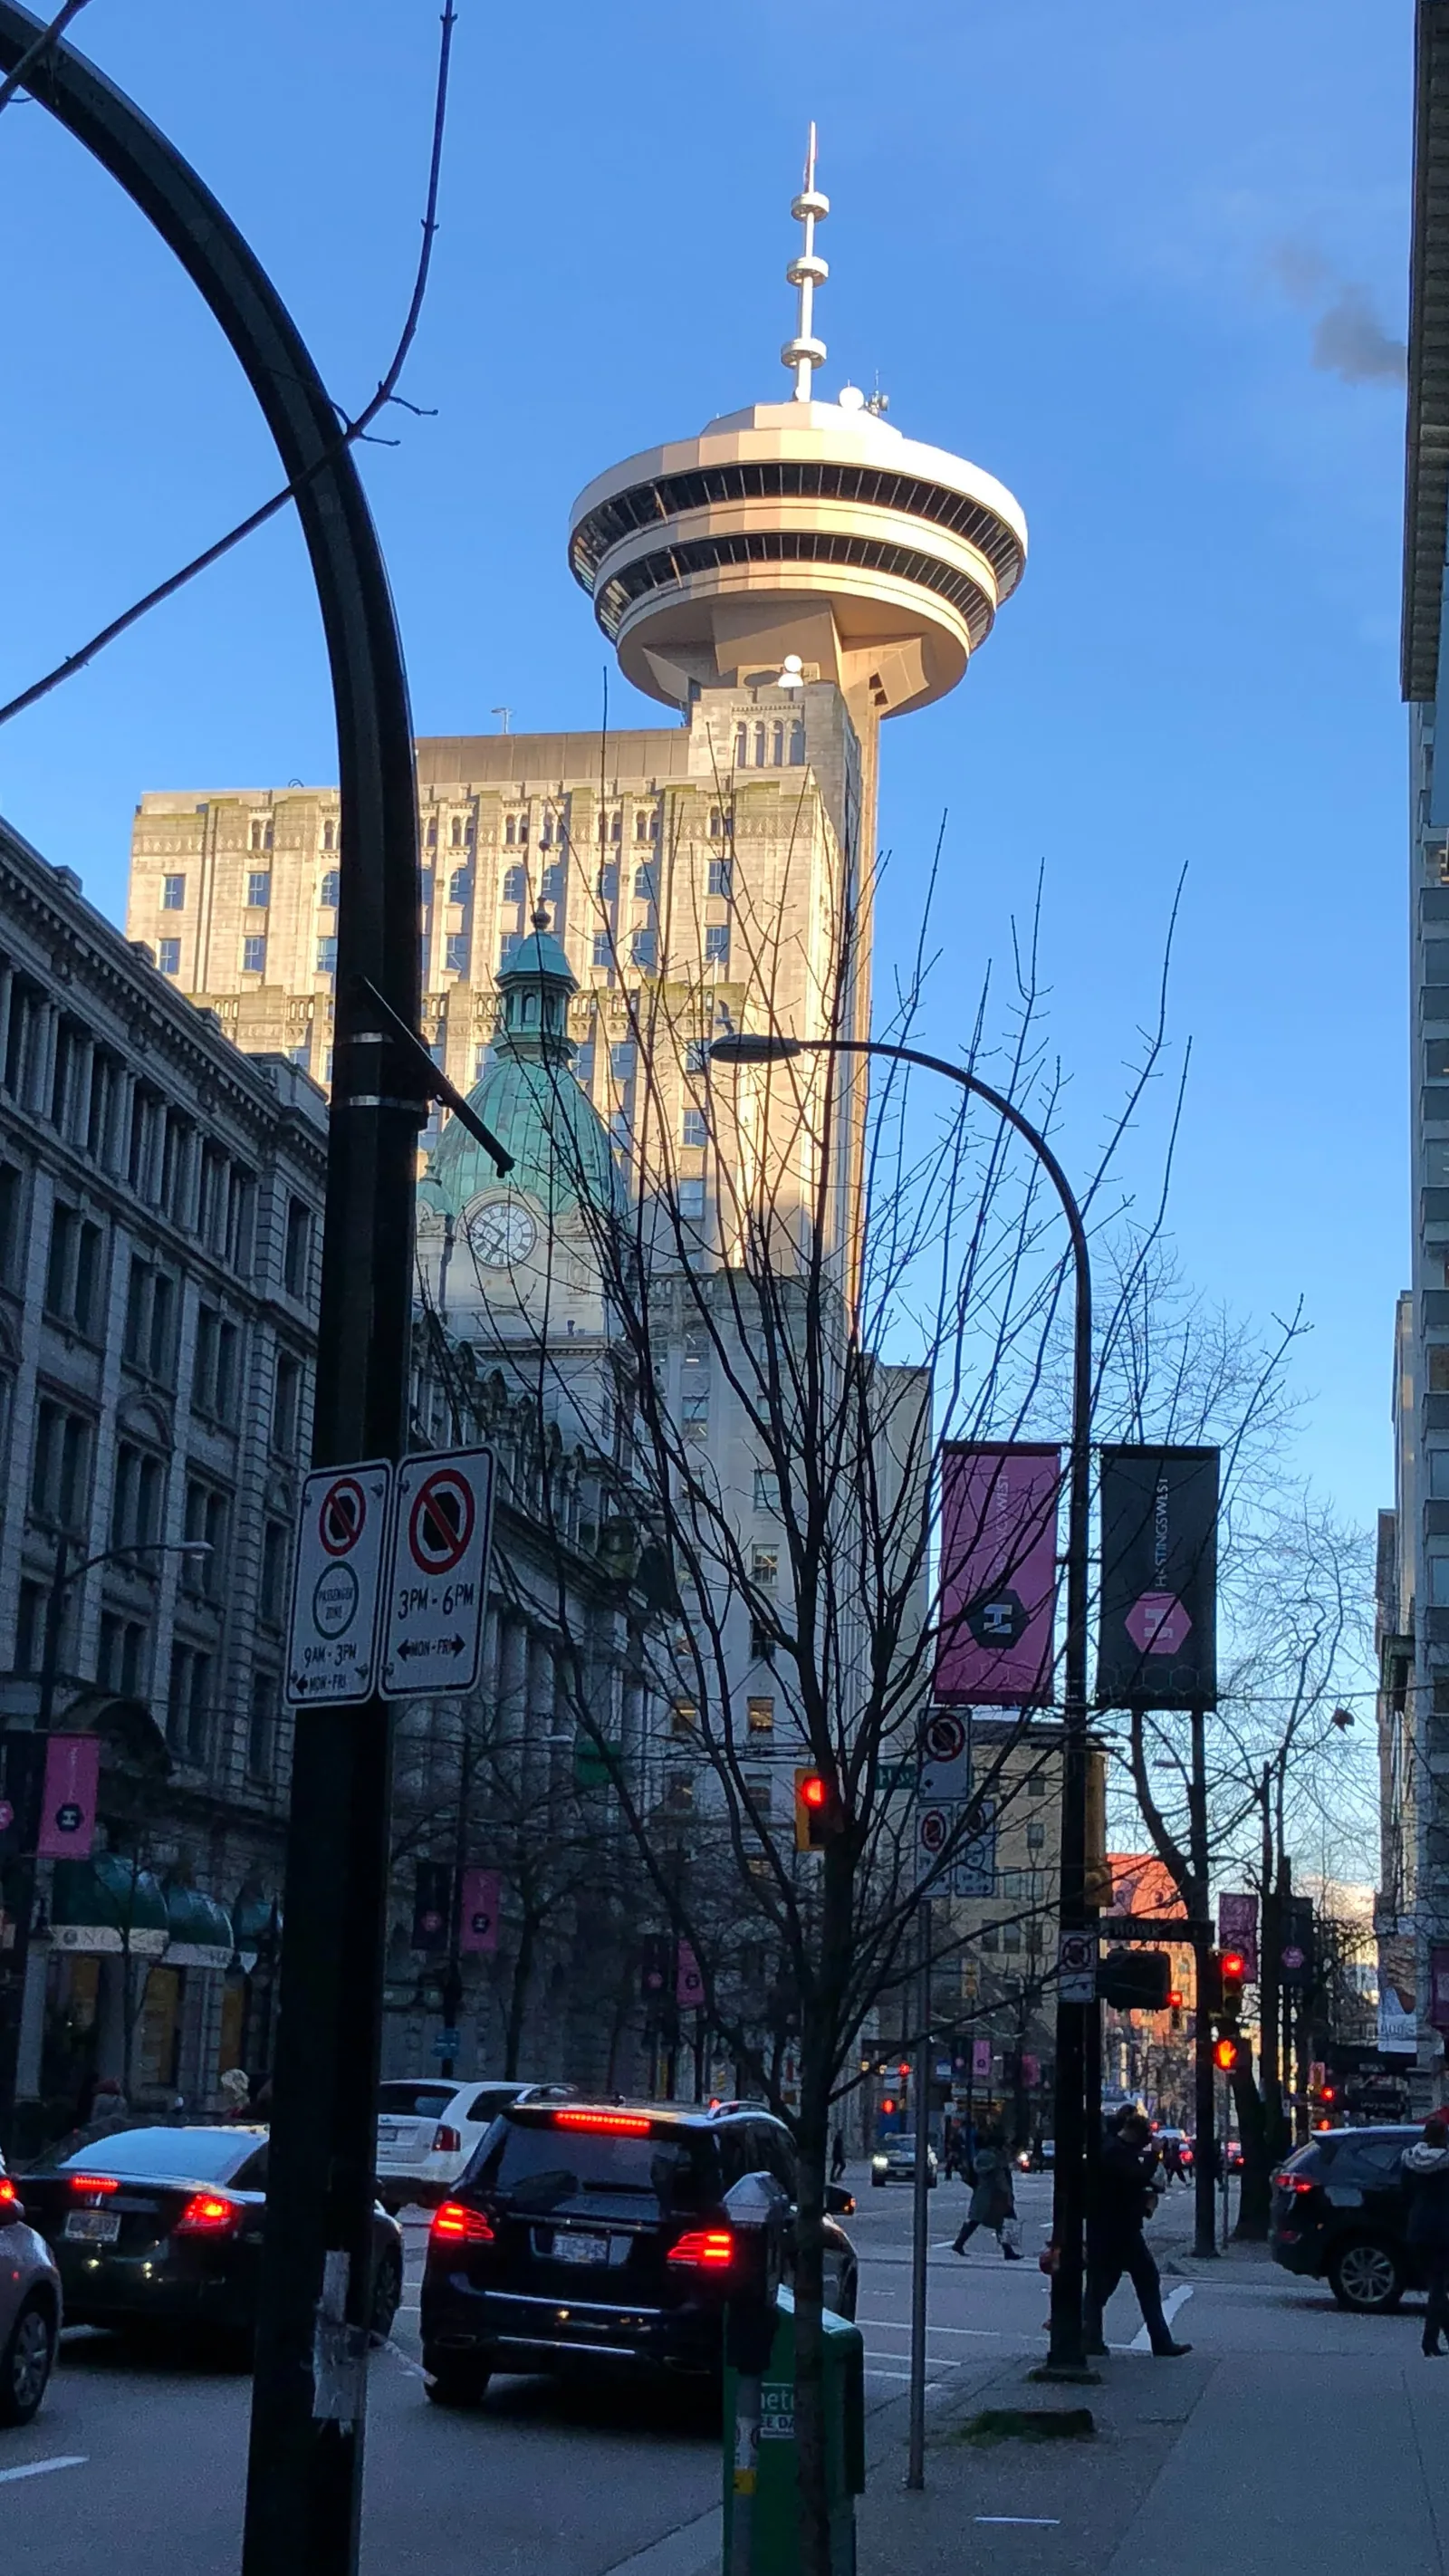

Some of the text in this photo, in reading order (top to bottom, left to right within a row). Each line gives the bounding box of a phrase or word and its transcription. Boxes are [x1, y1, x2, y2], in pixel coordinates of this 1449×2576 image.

[319, 1588, 354, 1601] PASSENGER
[398, 1587, 428, 1620] 3PM
[443, 1582, 475, 1616] 6PM
[325, 1607, 342, 1620] ZONE
[304, 1647, 326, 1668] 9AM
[334, 1643, 358, 1667] 3PM
[1114, 1922, 1161, 1938] HOWE
